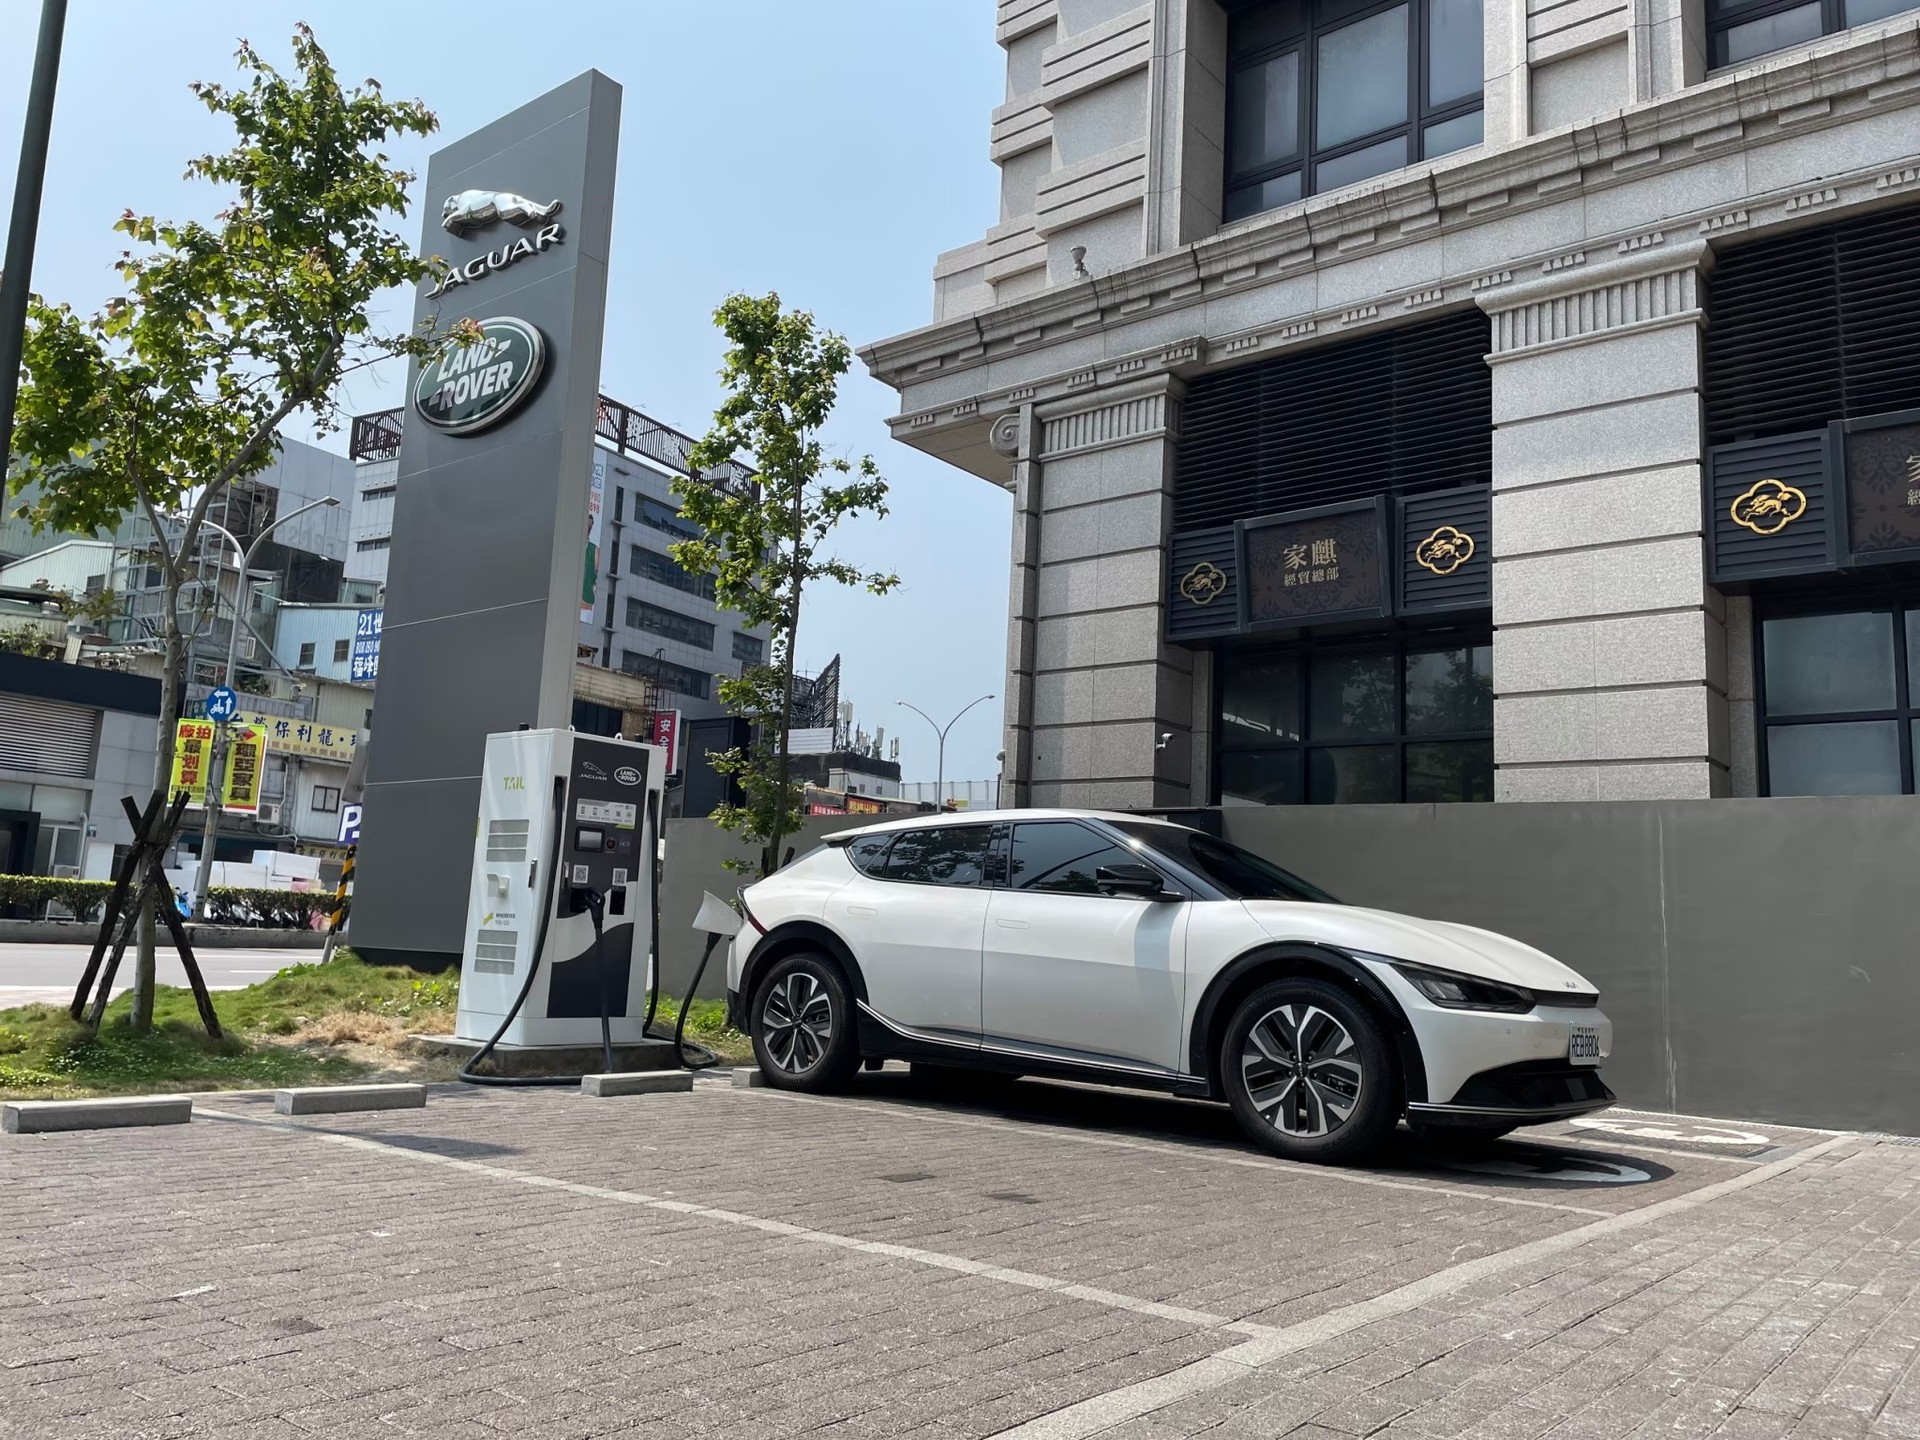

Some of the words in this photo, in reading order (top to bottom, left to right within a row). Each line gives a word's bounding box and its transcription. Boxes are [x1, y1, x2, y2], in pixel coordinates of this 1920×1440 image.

[424, 223, 562, 299] JAGUAR
[437, 337, 497, 383] LAND
[438, 361, 514, 411] ROVER
[659, 719, 671, 762] 安全
[578, 773, 607, 781] JAGUAR
[339, 805, 362, 841] P
